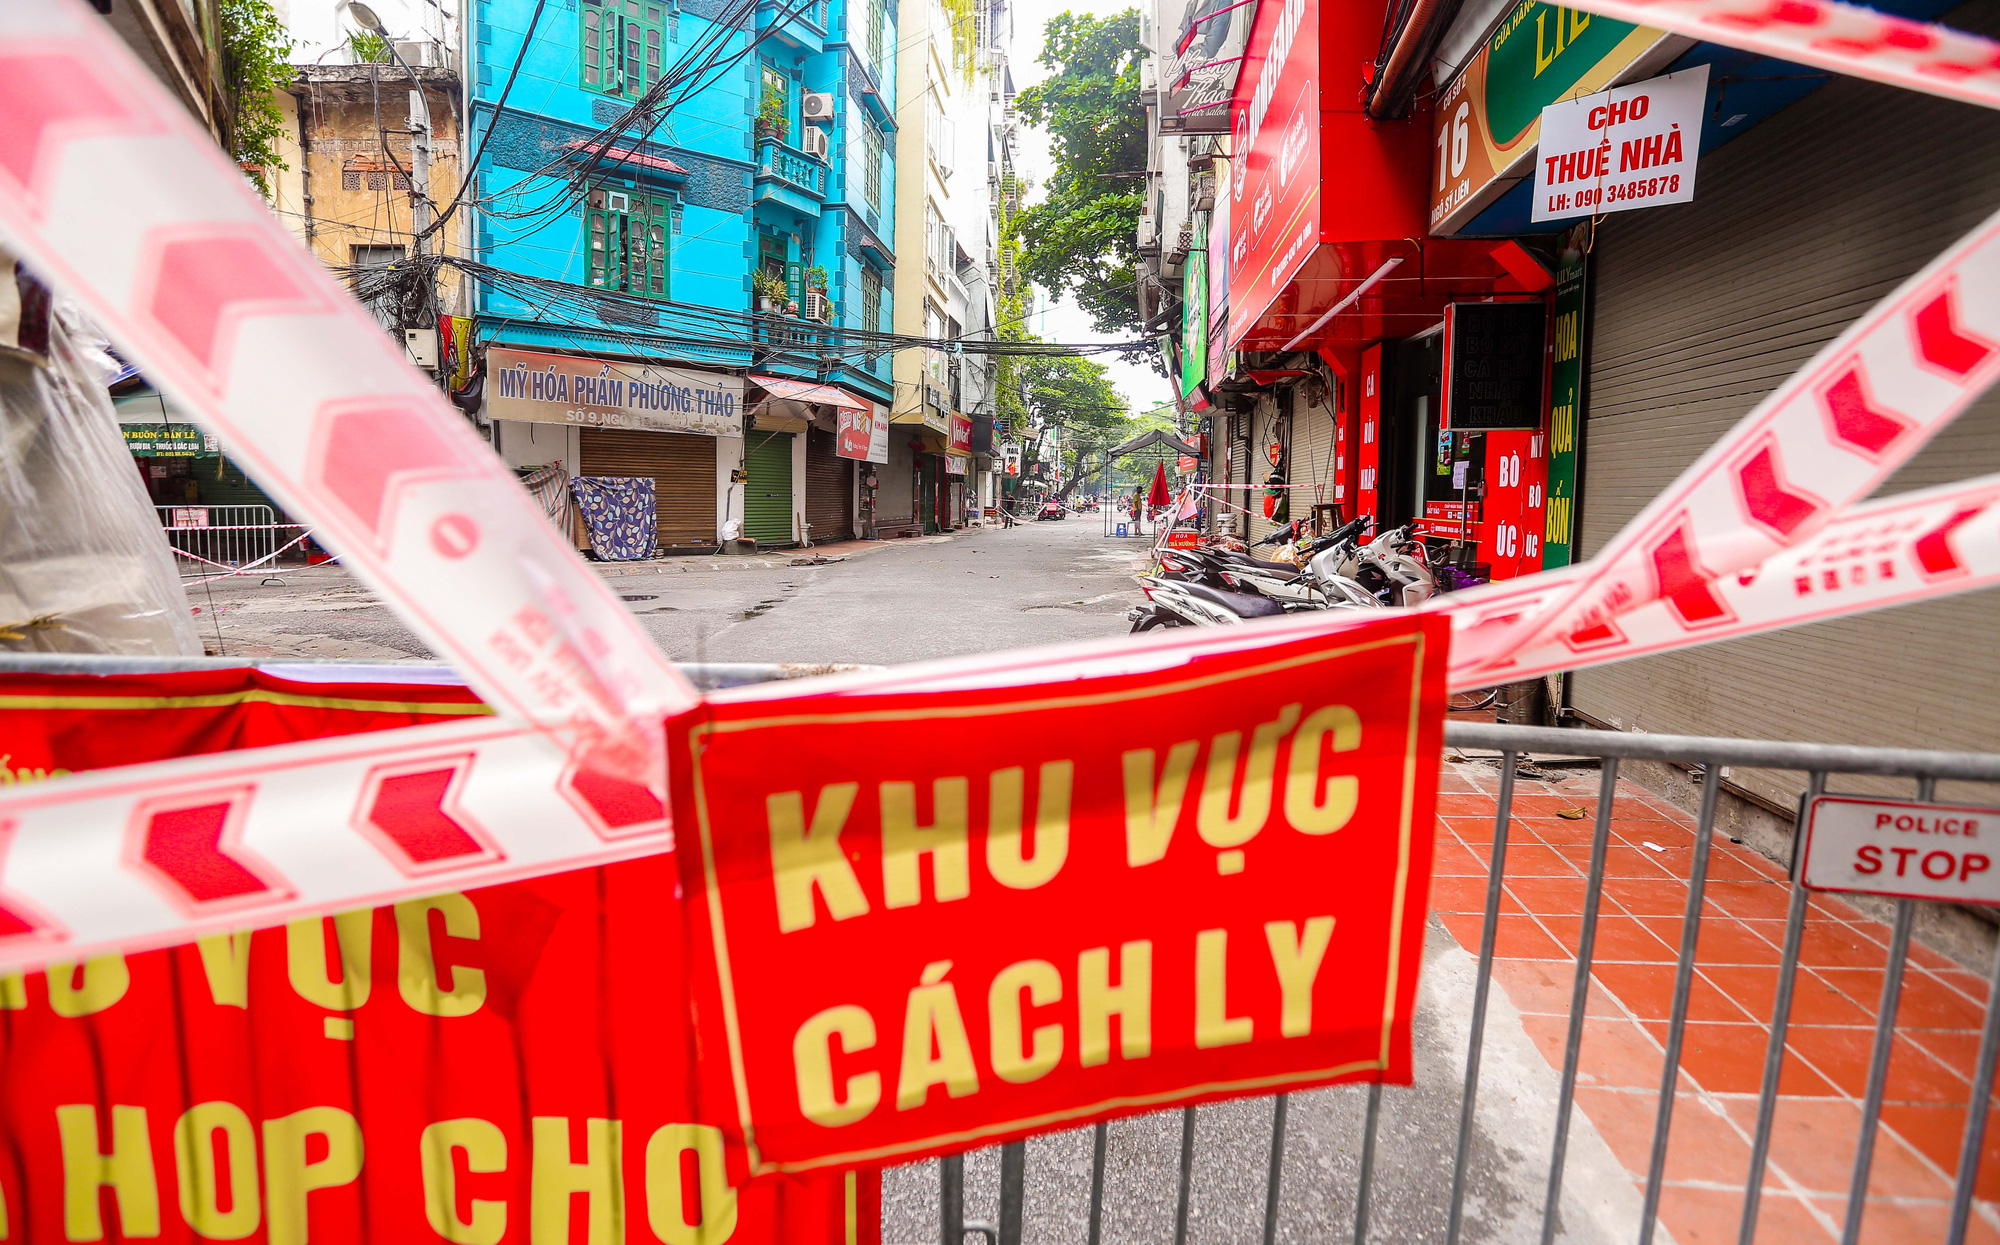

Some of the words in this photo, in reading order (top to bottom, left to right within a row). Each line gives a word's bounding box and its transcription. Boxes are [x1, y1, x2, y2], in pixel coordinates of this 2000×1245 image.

[1494, 23, 1511, 51] CỬA
[1533, 3, 1602, 80] LIL
[1462, 74, 1467, 89] 2
[1587, 95, 1650, 131] CHO
[1438, 101, 1469, 193] 16
[1545, 138, 1612, 186] THUÊ
[1619, 123, 1683, 173] NHÀ
[1548, 195, 1570, 213] LH:
[1575, 187, 1603, 208] 090
[1607, 174, 1680, 203] 3485878
[1555, 310, 1577, 363] HOA
[499, 362, 528, 400] MỸ
[533, 364, 569, 403] HÓA
[574, 364, 623, 408] PHẨM
[628, 380, 691, 414] PHƯƠNG
[695, 382, 735, 418] THẢO
[1366, 370, 1375, 398] CÁ
[132, 429, 157, 439] BUÔN
[566, 407, 586, 422] SỐ
[588, 412, 597, 423] 9
[1551, 387, 1573, 459] QUẢ
[1499, 450, 1520, 488] BÒ
[1528, 481, 1541, 508] BÒ
[1545, 480, 1570, 545] BỐN
[1496, 520, 1517, 558] ÚC
[1525, 531, 1538, 558] ÚC
[765, 760, 1074, 934] KHU
[1122, 703, 1363, 875] VỰC
[1876, 813, 1979, 838] POLICE
[1854, 844, 1990, 882] STOP
[792, 939, 1153, 1127] CÁCH
[1195, 915, 1336, 1050] LY
